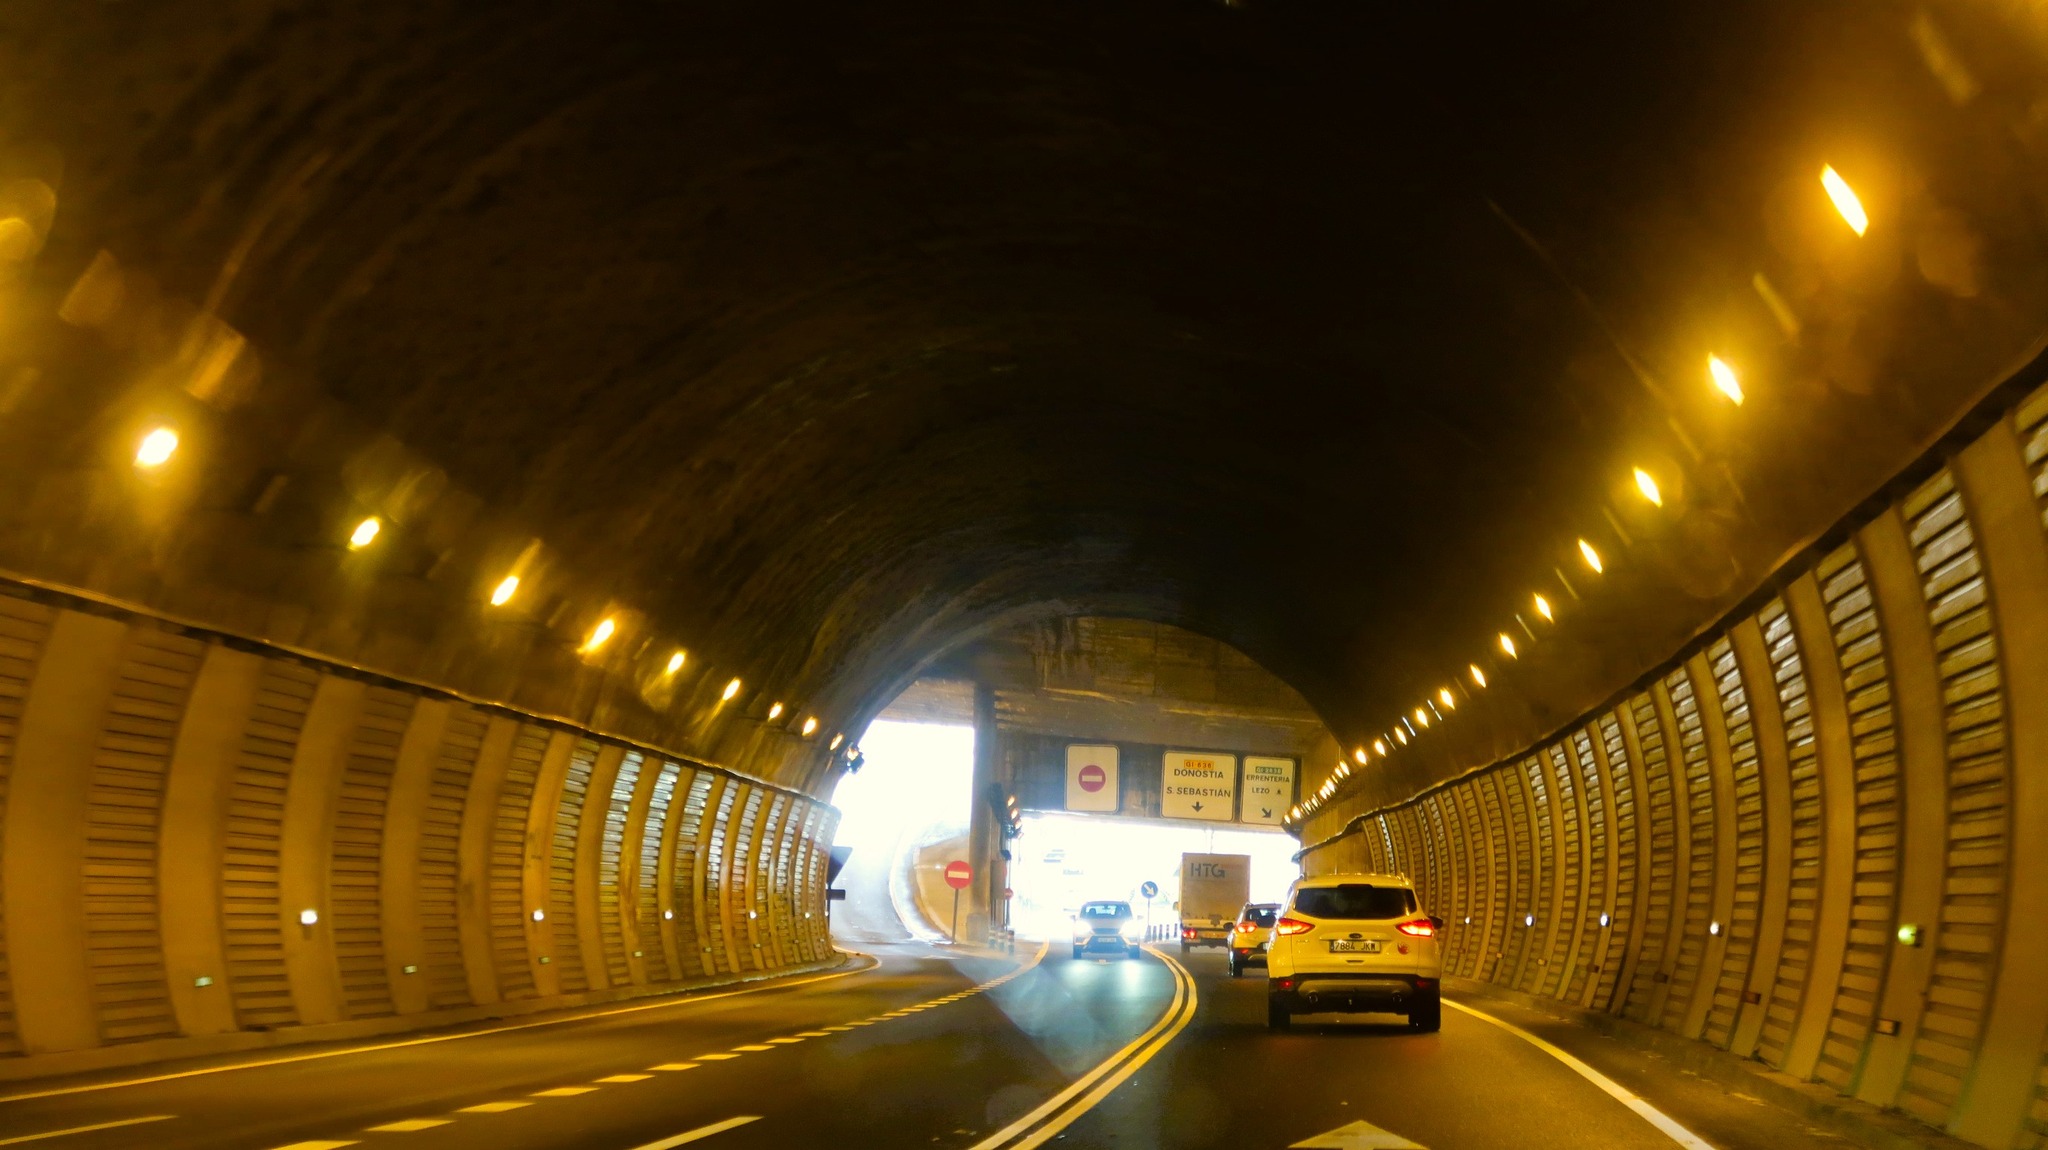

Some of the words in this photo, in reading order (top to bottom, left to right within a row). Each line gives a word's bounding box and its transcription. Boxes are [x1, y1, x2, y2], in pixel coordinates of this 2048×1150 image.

[1174, 768, 1224, 779] DONOSTIA
[1246, 774, 1290, 783] ERRENTERIA
[1176, 786, 1231, 798] SEBASTIÁN
[1251, 787, 1270, 795] LEZO
[1190, 862, 1226, 879] HTG
[1334, 942, 1355, 951] 7884
